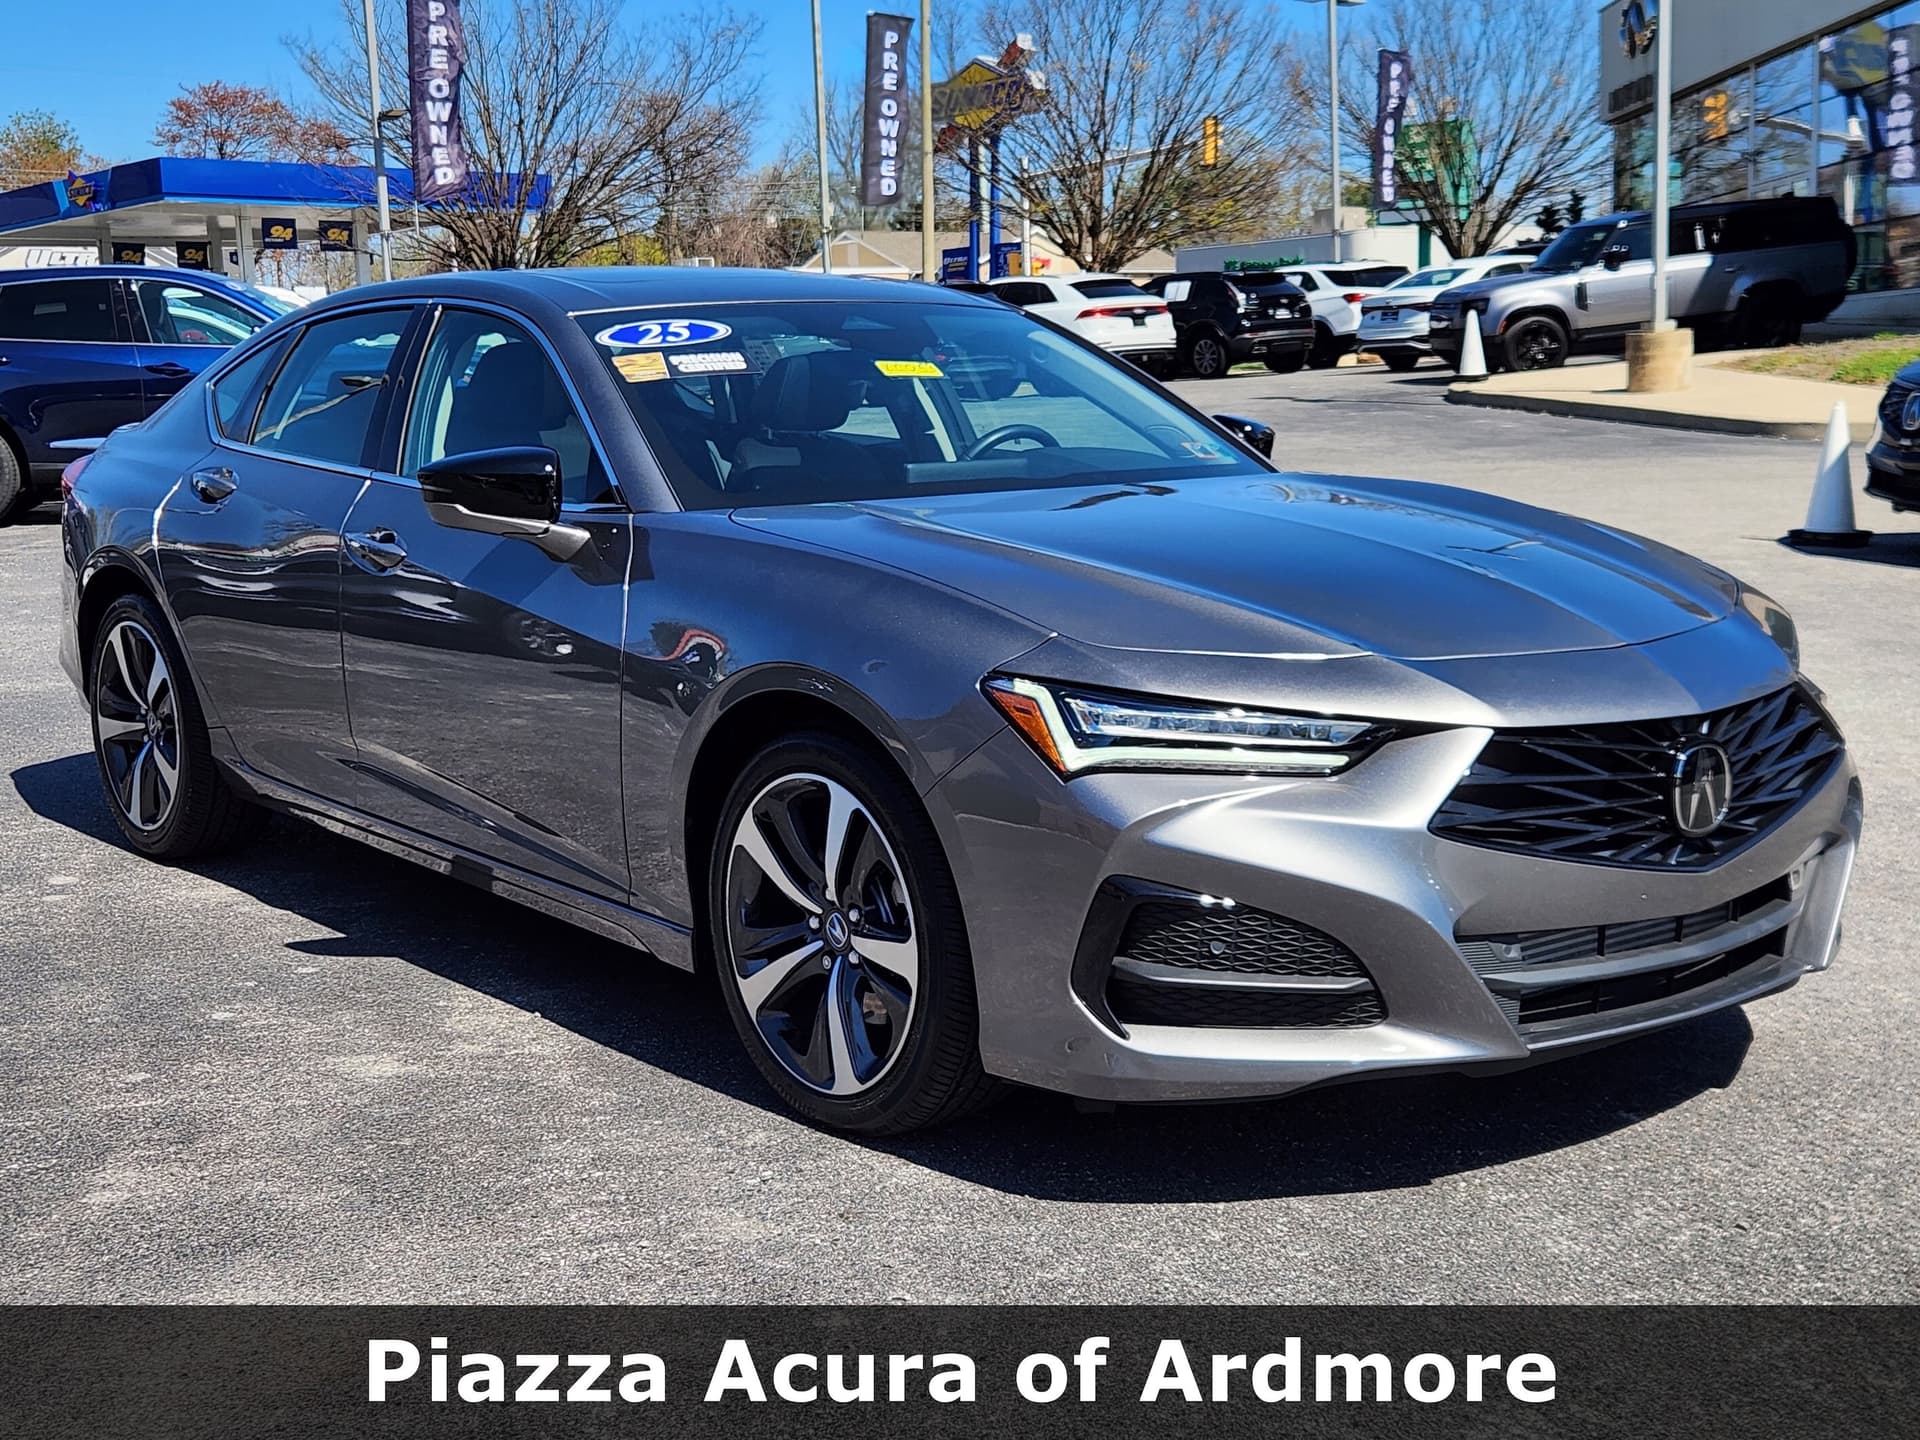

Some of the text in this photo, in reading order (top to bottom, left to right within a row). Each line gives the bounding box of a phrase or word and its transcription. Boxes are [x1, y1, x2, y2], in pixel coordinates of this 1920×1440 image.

[270, 225, 293, 241] 94
[121, 249, 142, 264] 94
[184, 249, 204, 263] 94
[638, 322, 691, 344] 25
